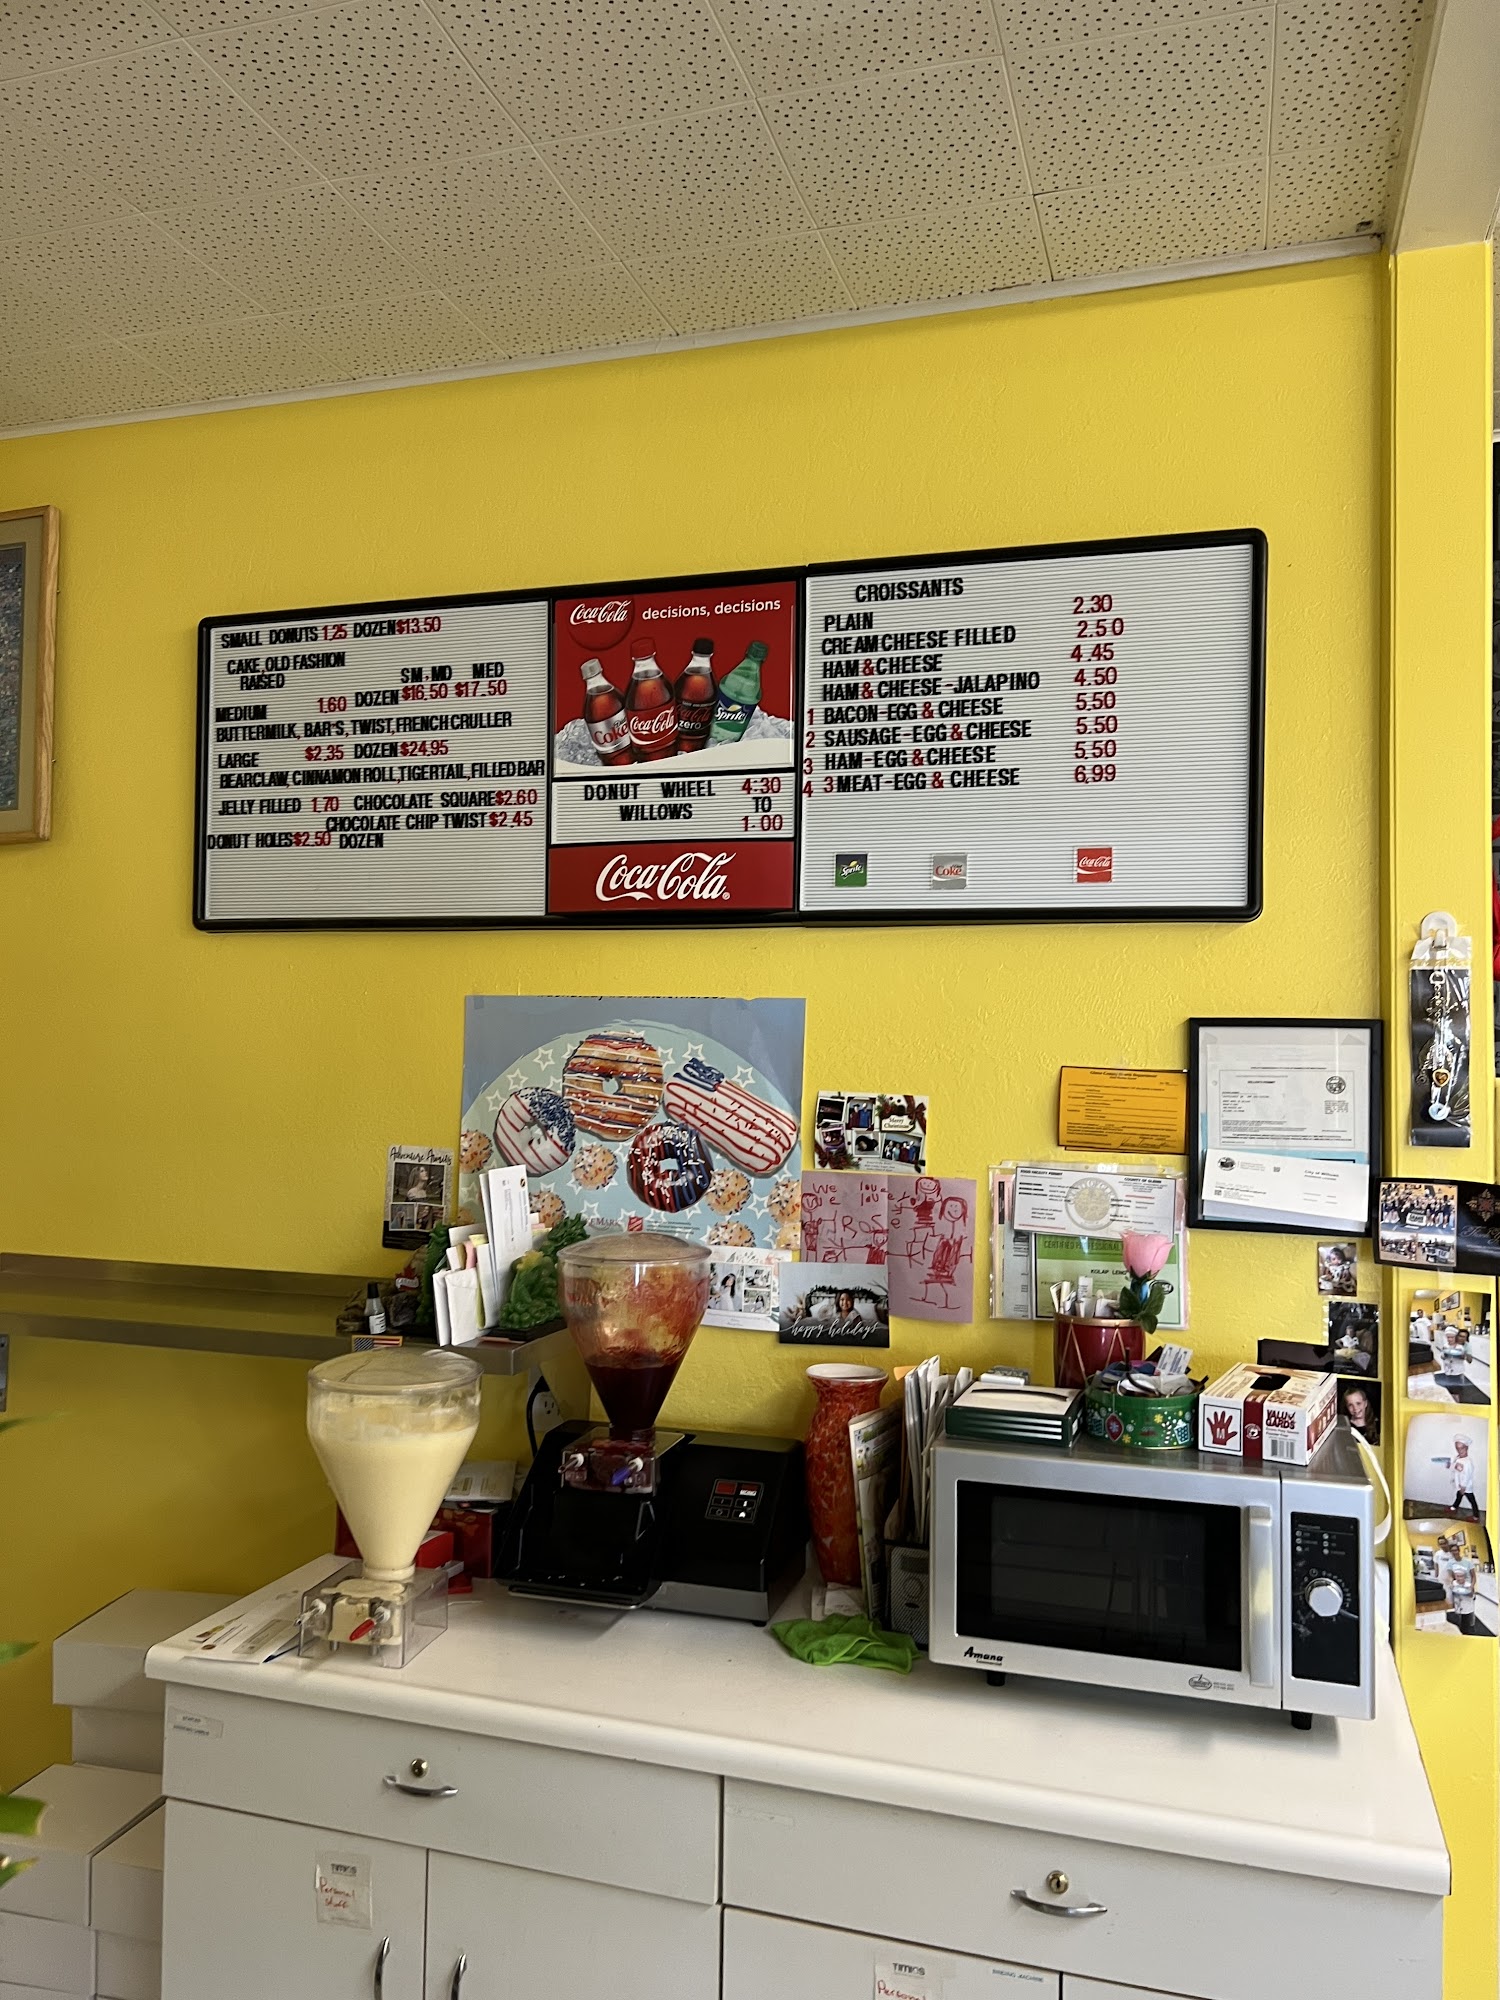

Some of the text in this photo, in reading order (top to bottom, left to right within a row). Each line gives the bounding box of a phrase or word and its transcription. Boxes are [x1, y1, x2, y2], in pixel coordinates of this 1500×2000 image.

[855, 577, 963, 602] CROISSANTS
[570, 600, 632, 625] Coca-Cola
[642, 599, 781, 620] decisions, decisions
[824, 595, 1113, 632] PLAIN 2.30
[221, 631, 262, 648] SMALL
[269, 626, 318, 644] DONUTS
[353, 620, 396, 638] DOZEN
[821, 618, 1124, 655] CREAM CHEESE FILLED 2.50
[293, 652, 346, 670] FASHION
[472, 662, 504, 679] MED
[822, 643, 1114, 678] HAM & CHEESE 4.45
[240, 673, 285, 691] RAISED
[822, 682, 859, 701] HAM
[862, 681, 874, 699] &
[1074, 667, 1117, 686] 4.50
[215, 679, 507, 722] MEDIUM 1.60 DOZEN $16.50 $17.50
[807, 691, 1116, 725] 1 BACON-EGG & CHEESE 5.50
[450, 711, 512, 730] CRULLER
[630, 706, 675, 735] Coca-Cola
[679, 720, 702, 729] zero
[715, 707, 746, 721] Sprite
[805, 715, 1118, 748] 2 SAUSAGE-EGG & CHEESE 5.50
[218, 740, 449, 769] LARGE $2.35 DOZEN $24.95
[803, 739, 1117, 774] 3 HAM-EGG & CHEESE 5.50
[292, 768, 360, 786] CINNAMON
[471, 761, 515, 779] FILLED
[517, 760, 545, 777] BAR
[802, 780, 814, 798] 4
[931, 771, 944, 788] &
[950, 768, 1020, 788] CHEESE
[1074, 763, 1117, 784] 6.99
[584, 780, 717, 801] DONUT WHEEL
[742, 777, 781, 795] 4:30
[218, 789, 538, 816] JELLY FILLED 1.70 CHOCOLATE SQUARE $2.60
[619, 803, 693, 822] WILLOWS
[752, 796, 772, 813] TO
[326, 811, 534, 832] CHOCOLATE CHIP TWIST $2.45
[208, 834, 250, 849] DONUT
[255, 832, 293, 848] HOLES
[339, 832, 384, 849] DOZEN
[840, 865, 863, 877] Sprite
[935, 865, 963, 876] Coke
[1078, 856, 1112, 868] Coca-Cola
[595, 852, 737, 902] Coca-Cola
[1043, 1240, 1075, 1250] CERTIFIED
[963, 1646, 1004, 1662] Amana
